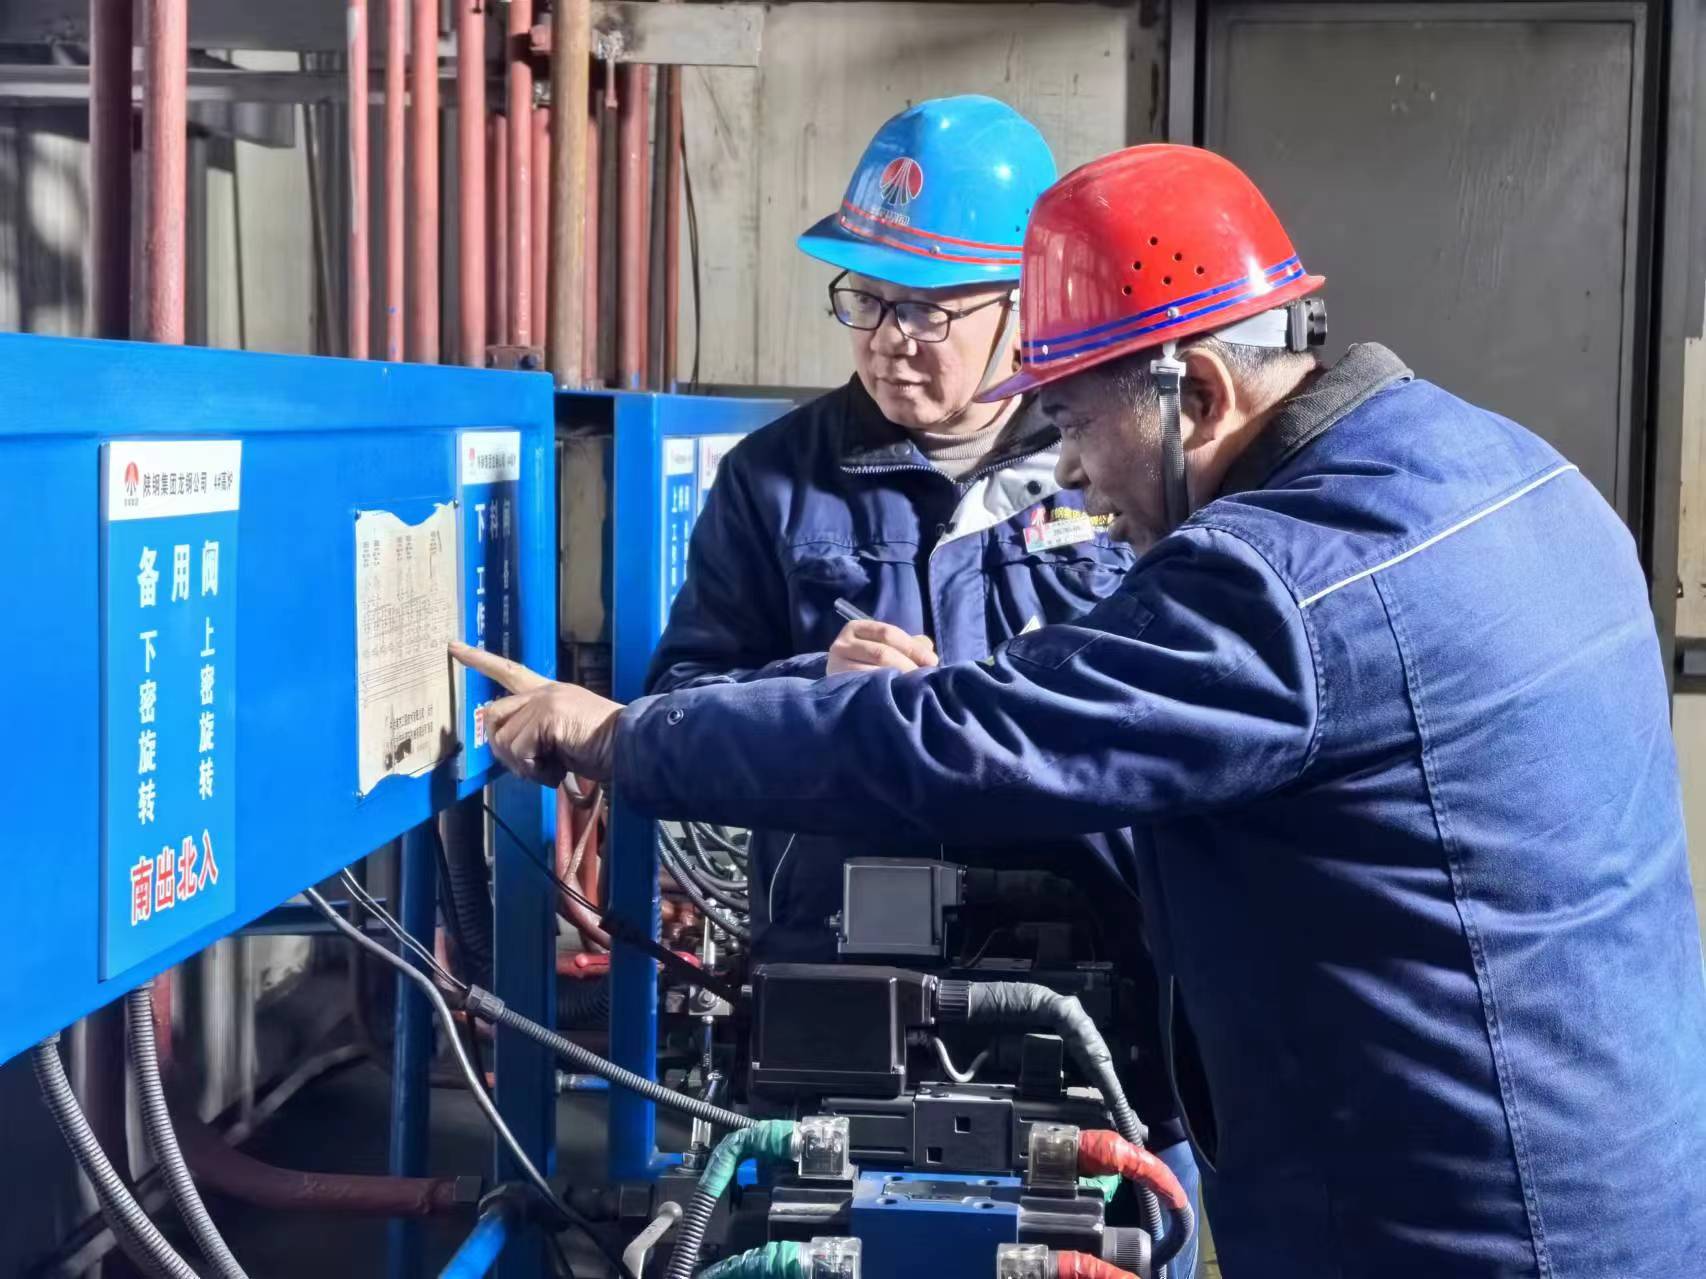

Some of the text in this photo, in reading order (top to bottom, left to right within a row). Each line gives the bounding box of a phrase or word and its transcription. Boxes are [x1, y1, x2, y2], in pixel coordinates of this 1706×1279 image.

[143, 472, 207, 498] 陕钢集团龙钢公司
[137, 540, 220, 608] 备用阀
[137, 629, 159, 825] 下密旋转
[198, 616, 216, 801] 上密旋转
[130, 828, 219, 926] 南出北入
